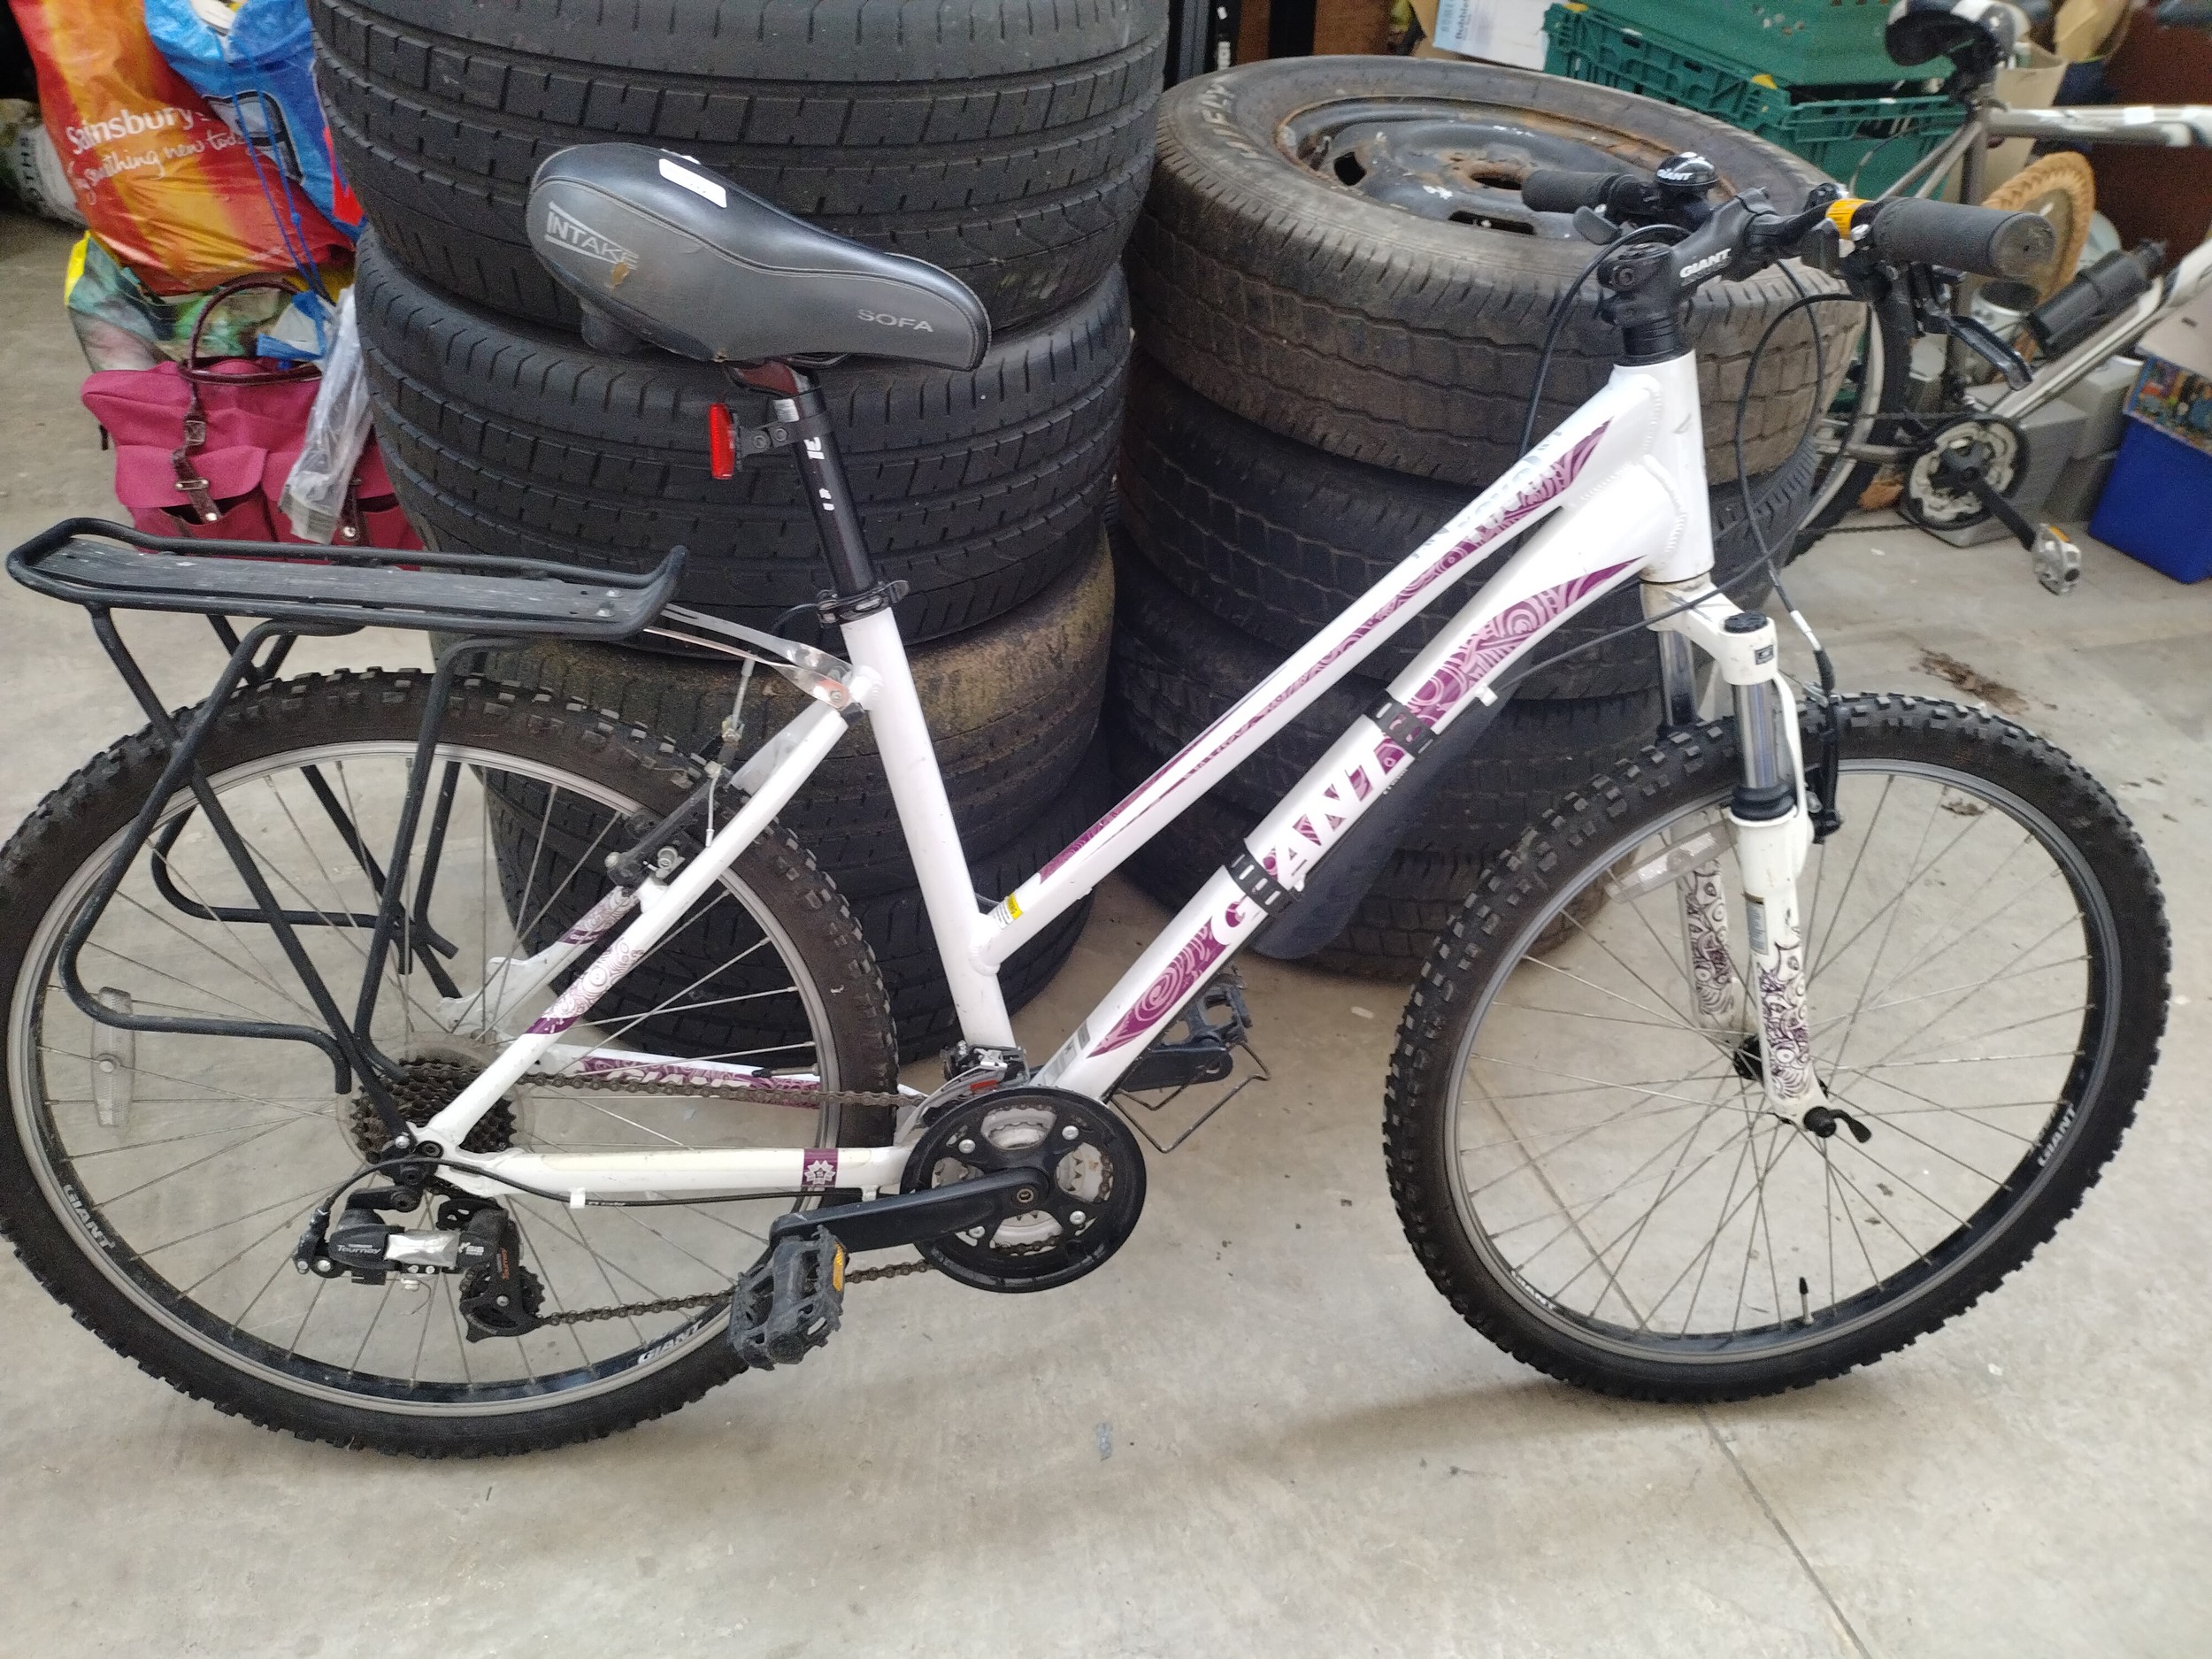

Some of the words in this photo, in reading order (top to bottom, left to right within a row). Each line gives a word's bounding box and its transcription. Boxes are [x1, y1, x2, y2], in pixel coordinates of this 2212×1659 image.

[545, 209, 639, 270] INTAKE
[1679, 248, 1732, 278] GIANT
[856, 309, 934, 333] SOFA
[1211, 732, 1386, 945] GANT
[63, 1184, 116, 1249] GIANT
[337, 1244, 381, 1255] Tourney
